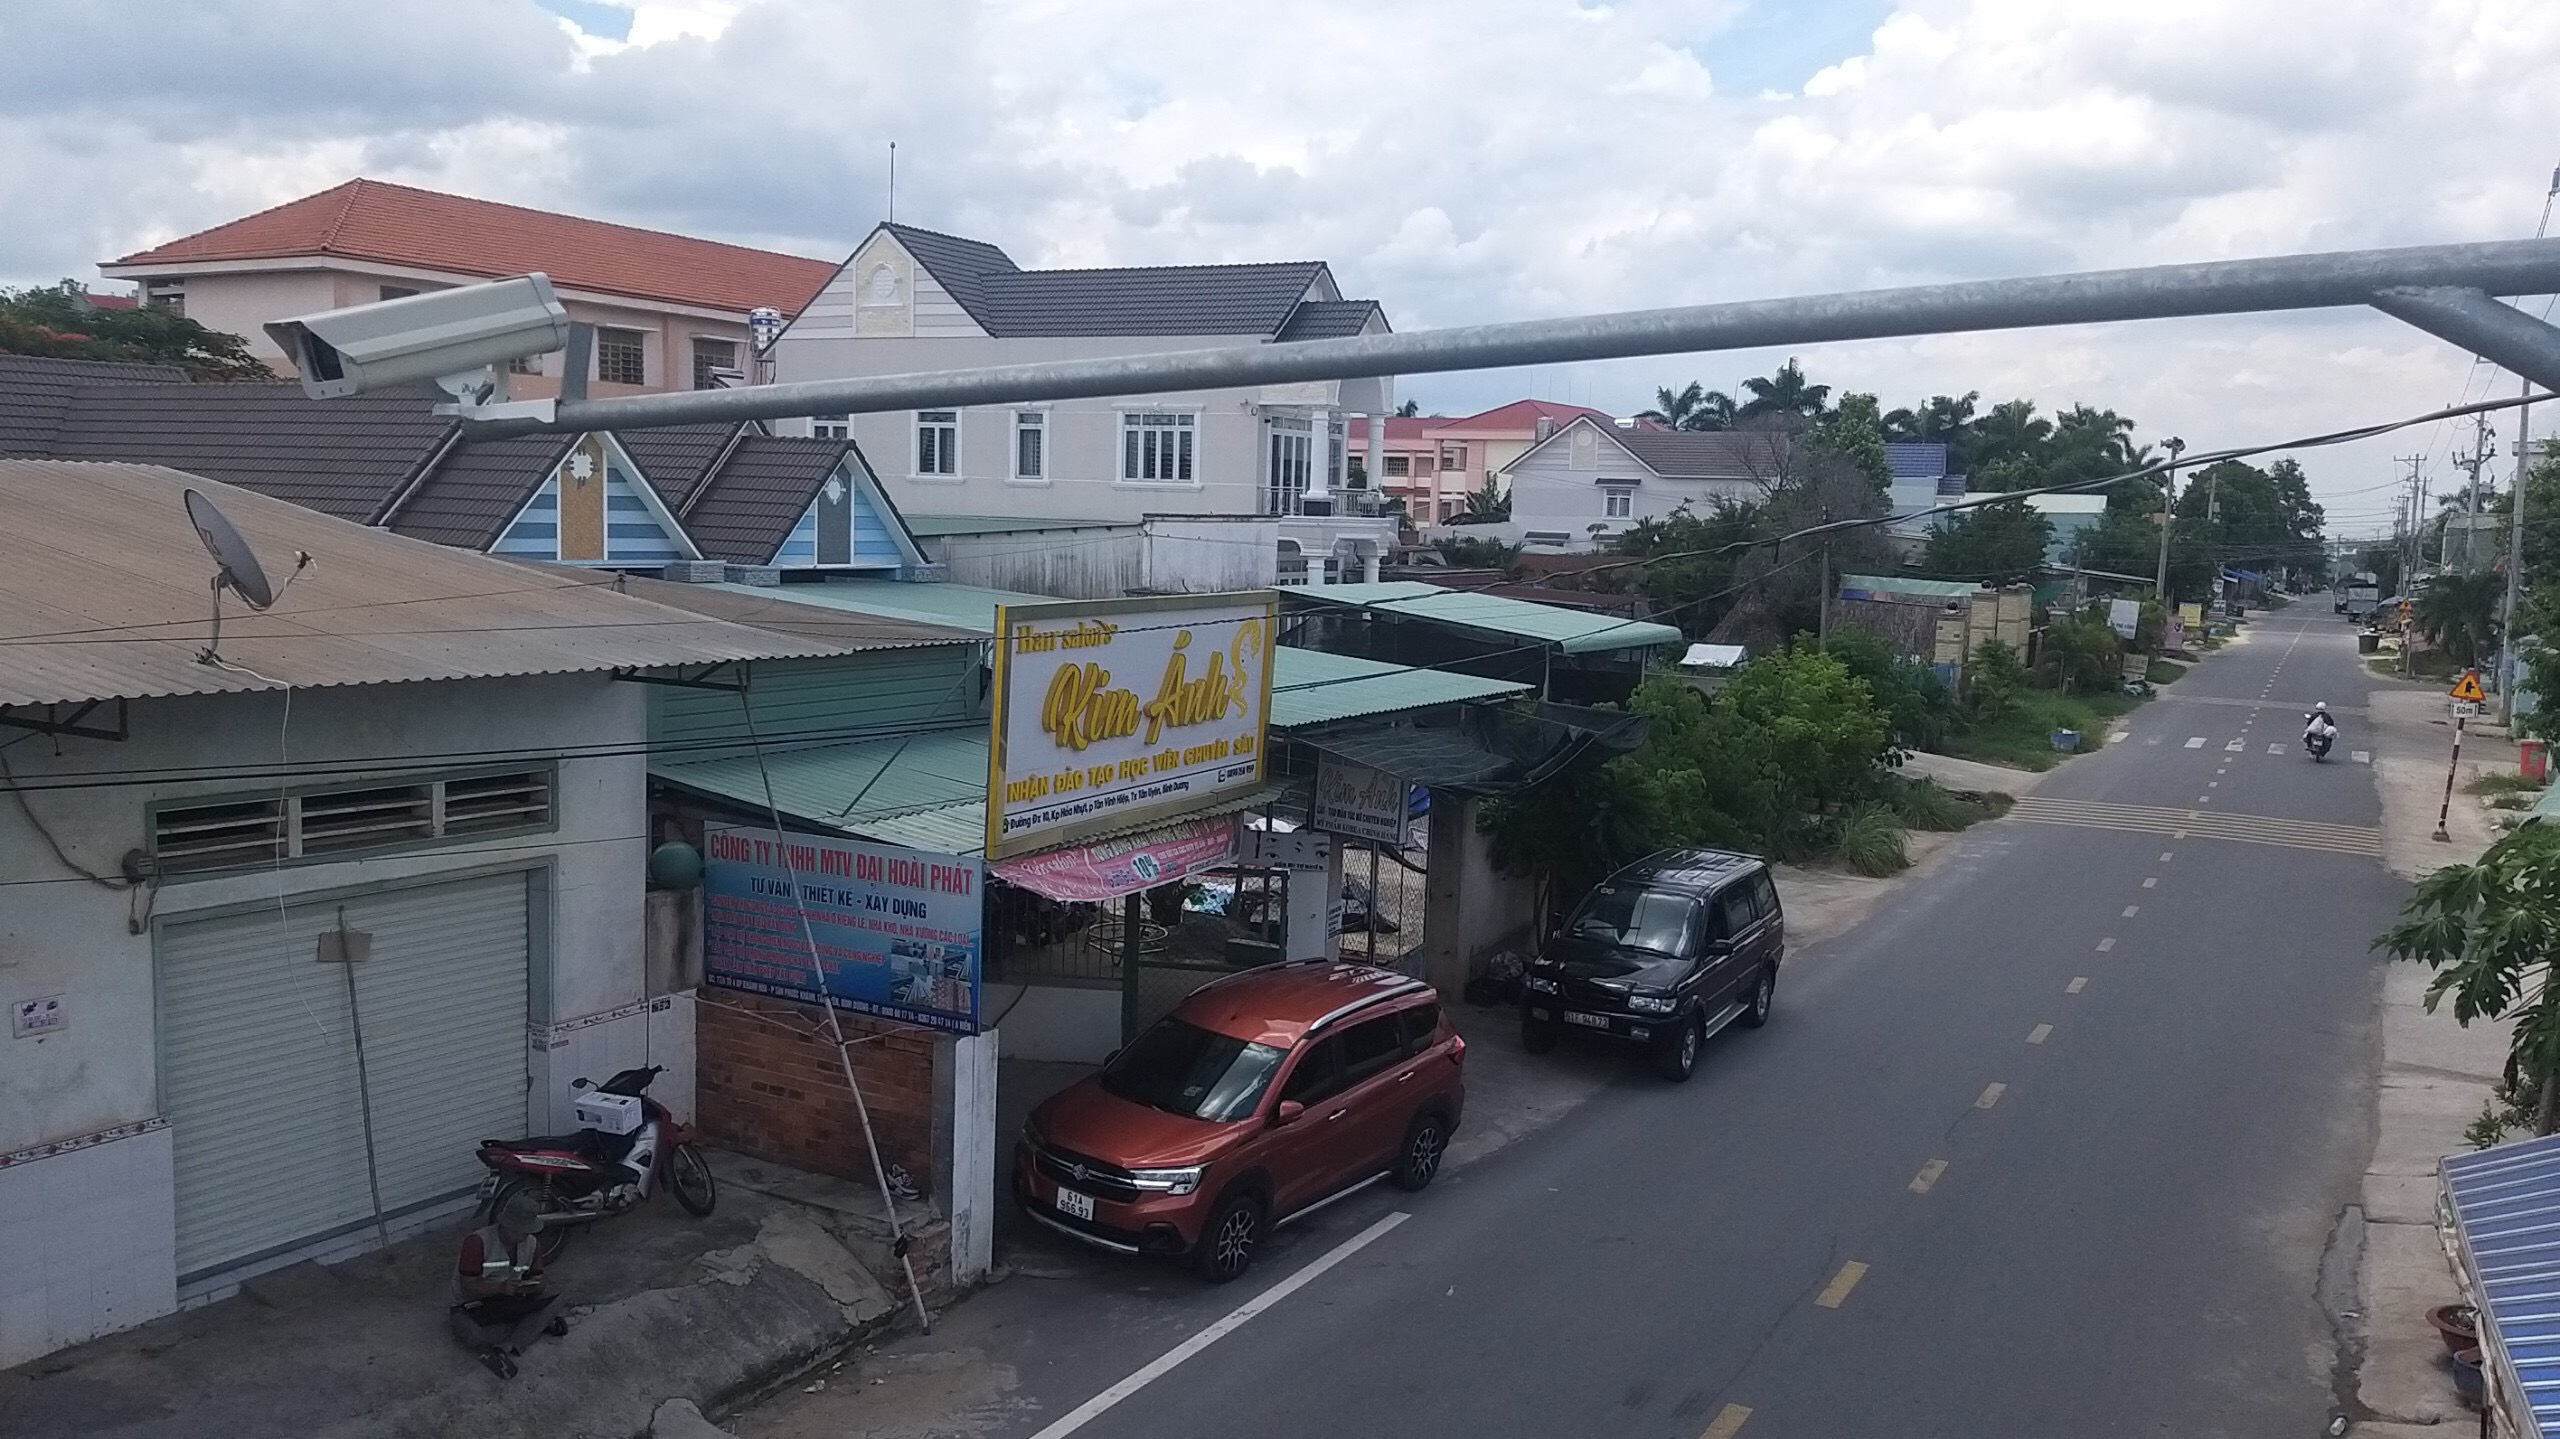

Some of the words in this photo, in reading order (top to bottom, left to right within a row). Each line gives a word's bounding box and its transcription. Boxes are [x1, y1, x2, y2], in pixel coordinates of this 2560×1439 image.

[1042, 662, 1142, 751] Kim
[1143, 630, 1230, 745] Ánh
[2456, 706, 2474, 715] 50m
[1006, 774, 1050, 804] NHẬN
[1053, 766, 1085, 795] ĐÀO
[1088, 764, 1115, 788] TẠO
[1118, 757, 1150, 782] HỌC
[1152, 748, 1179, 772] VIÊN
[1183, 738, 1229, 766] CHUYÊN
[1320, 767, 1356, 806] Kim
[711, 829, 750, 863] CÔNG
[755, 840, 771, 866] TY
[821, 849, 852, 877] MTV
[857, 853, 883, 887] ĐẠI
[888, 856, 926, 889] HOÀI
[931, 862, 973, 896] PHÁT
[751, 877, 765, 893] TƯ
[768, 873, 791, 897] VẤN
[803, 882, 834, 903] THIẾT
[838, 887, 853, 907] KẾ
[865, 893, 888, 912] XÂY
[893, 898, 927, 919] DỰNG
[1067, 1191, 1083, 1205] 61A
